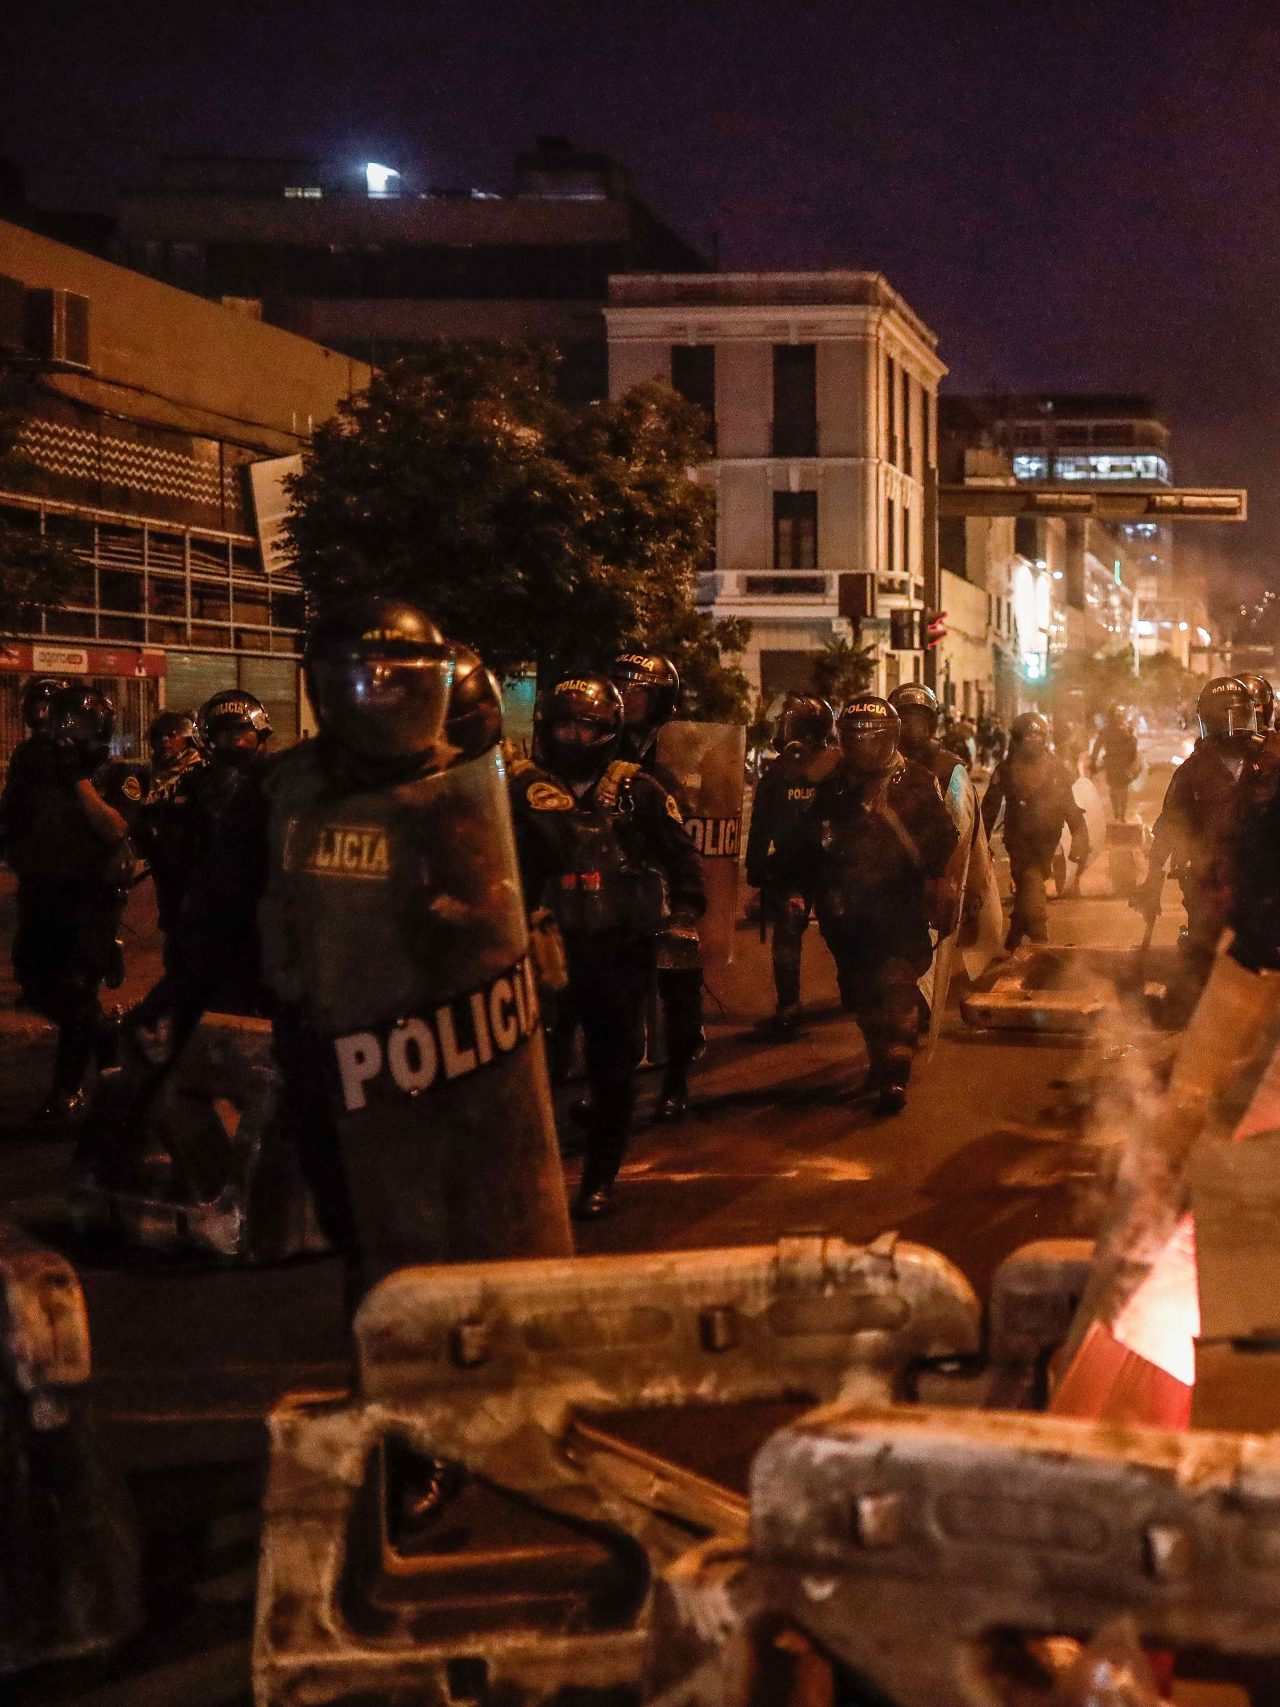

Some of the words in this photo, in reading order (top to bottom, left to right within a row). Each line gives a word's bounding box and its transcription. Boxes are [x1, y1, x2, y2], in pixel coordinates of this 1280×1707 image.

[616, 653, 656, 671] OLICIA
[554, 679, 598, 696] POLIC
[315, 831, 392, 872] LICIA
